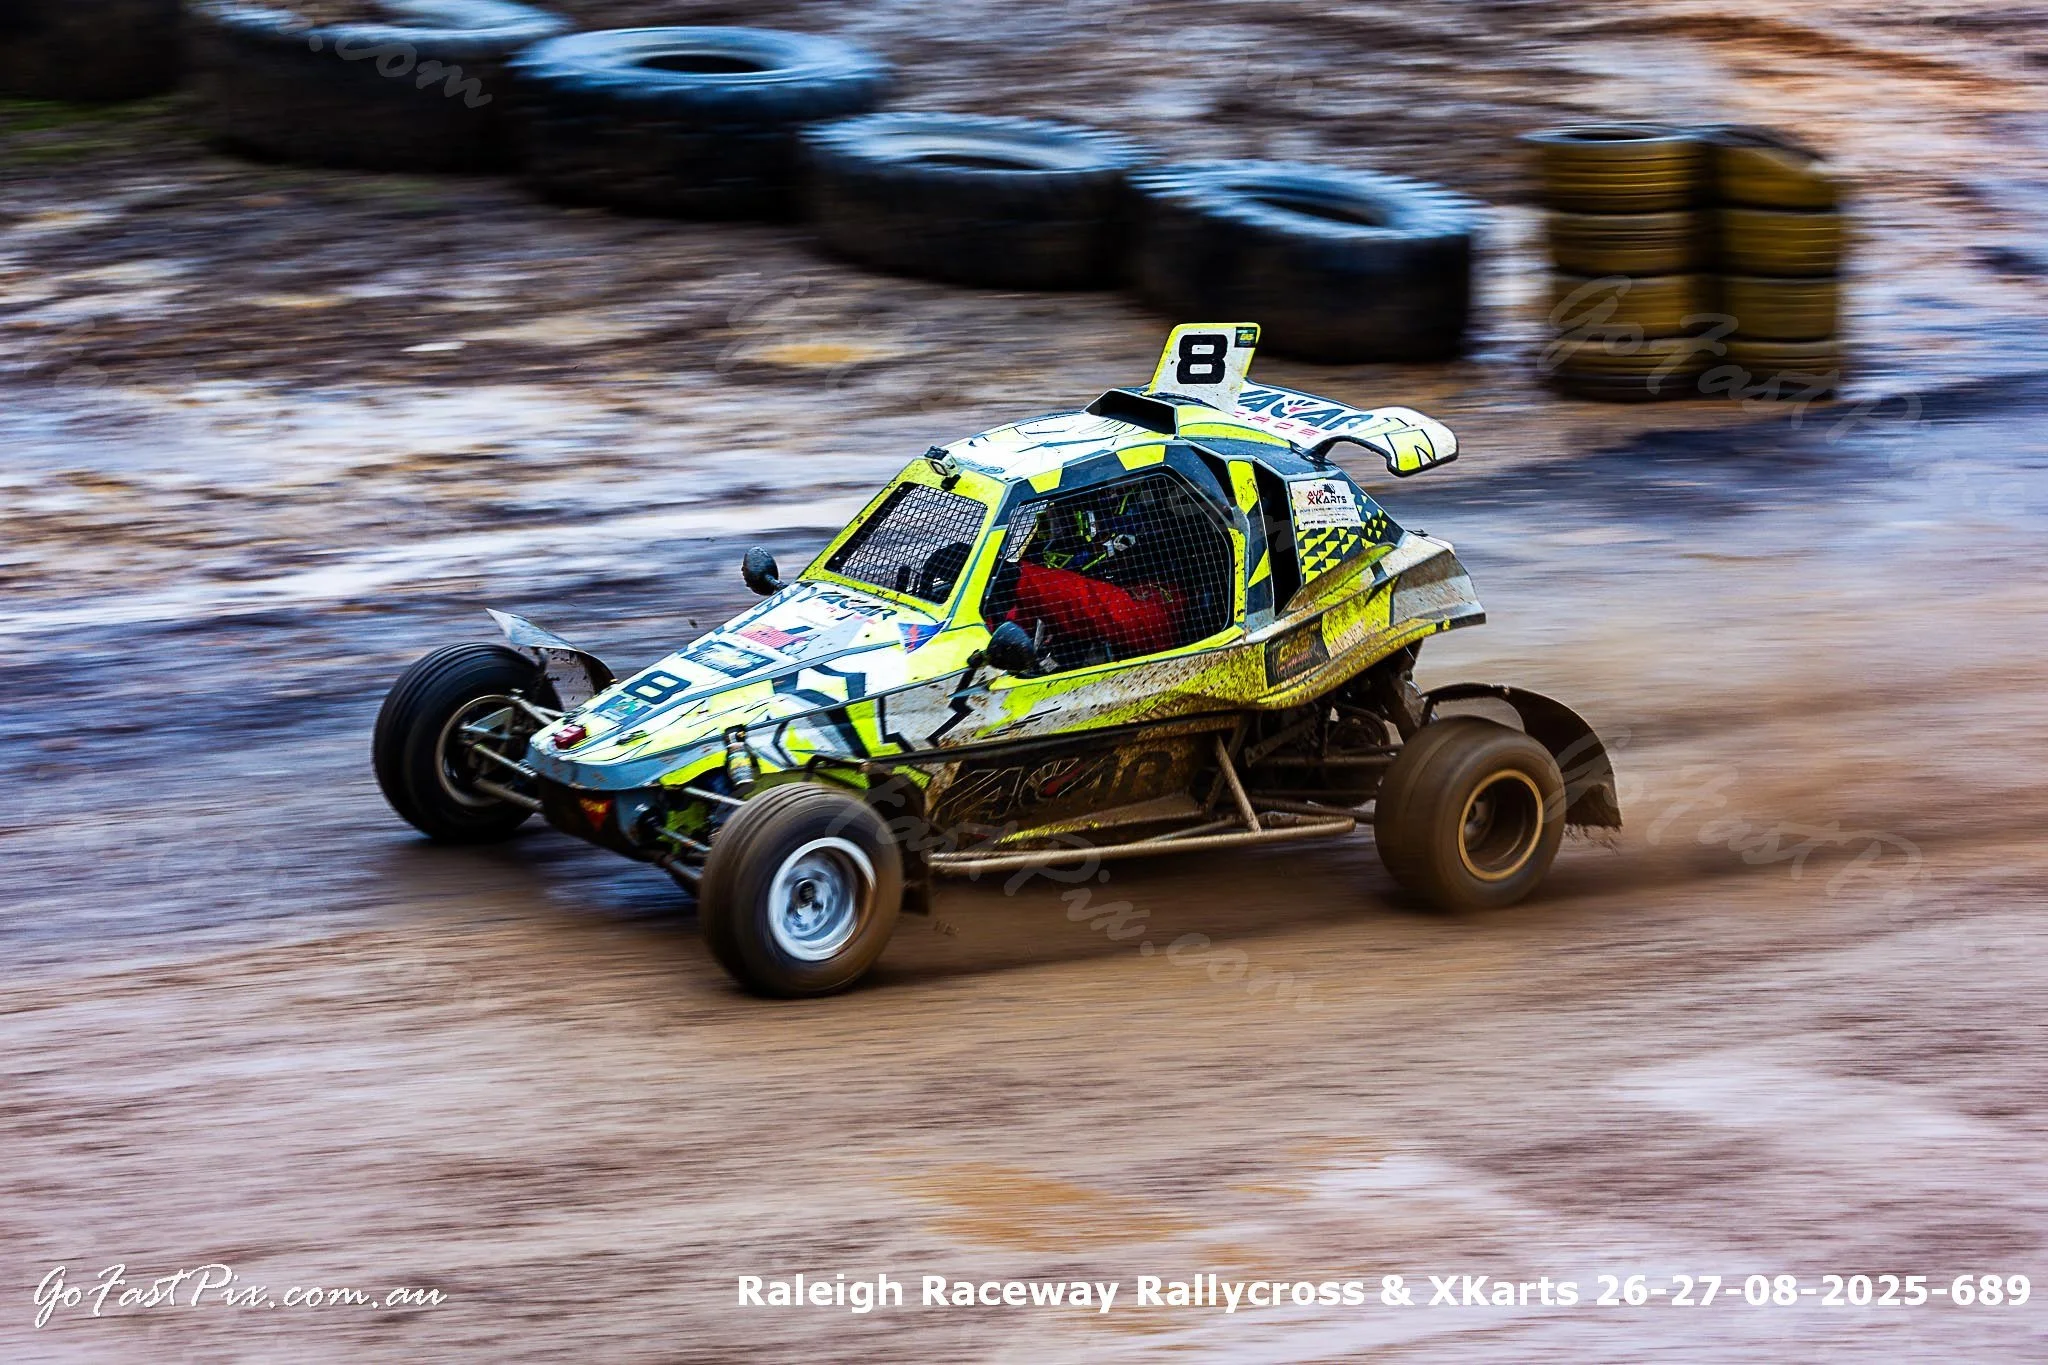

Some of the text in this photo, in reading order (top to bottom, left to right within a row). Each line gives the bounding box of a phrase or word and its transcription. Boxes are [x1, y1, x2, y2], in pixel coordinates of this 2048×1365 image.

[1176, 334, 1228, 384] 8
[1307, 495, 1347, 505] XKARTS
[621, 670, 692, 705] 8
